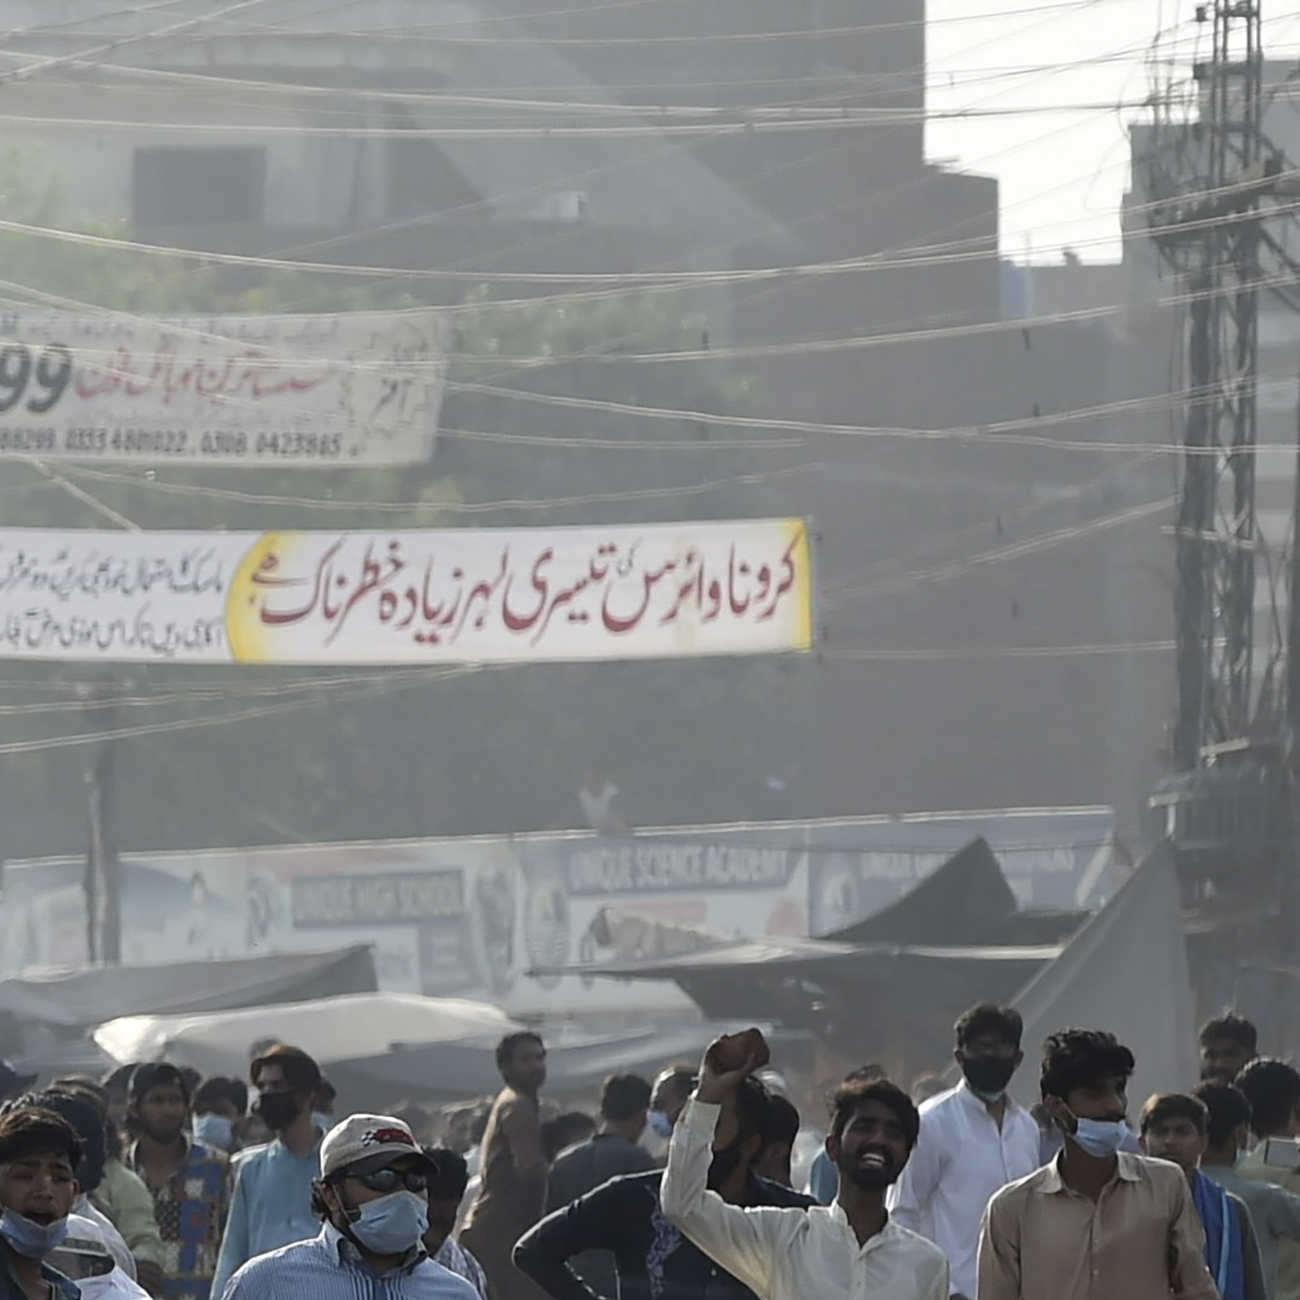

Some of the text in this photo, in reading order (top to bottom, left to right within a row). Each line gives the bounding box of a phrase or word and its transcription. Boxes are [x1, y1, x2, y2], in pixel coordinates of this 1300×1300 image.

[259, 535, 408, 648] خطرناک
[378, 552, 464, 645] زیادہ
[448, 541, 510, 645] لہر
[502, 545, 620, 648] تیسری
[602, 550, 723, 633] وائرس
[727, 531, 805, 622] کرونا
